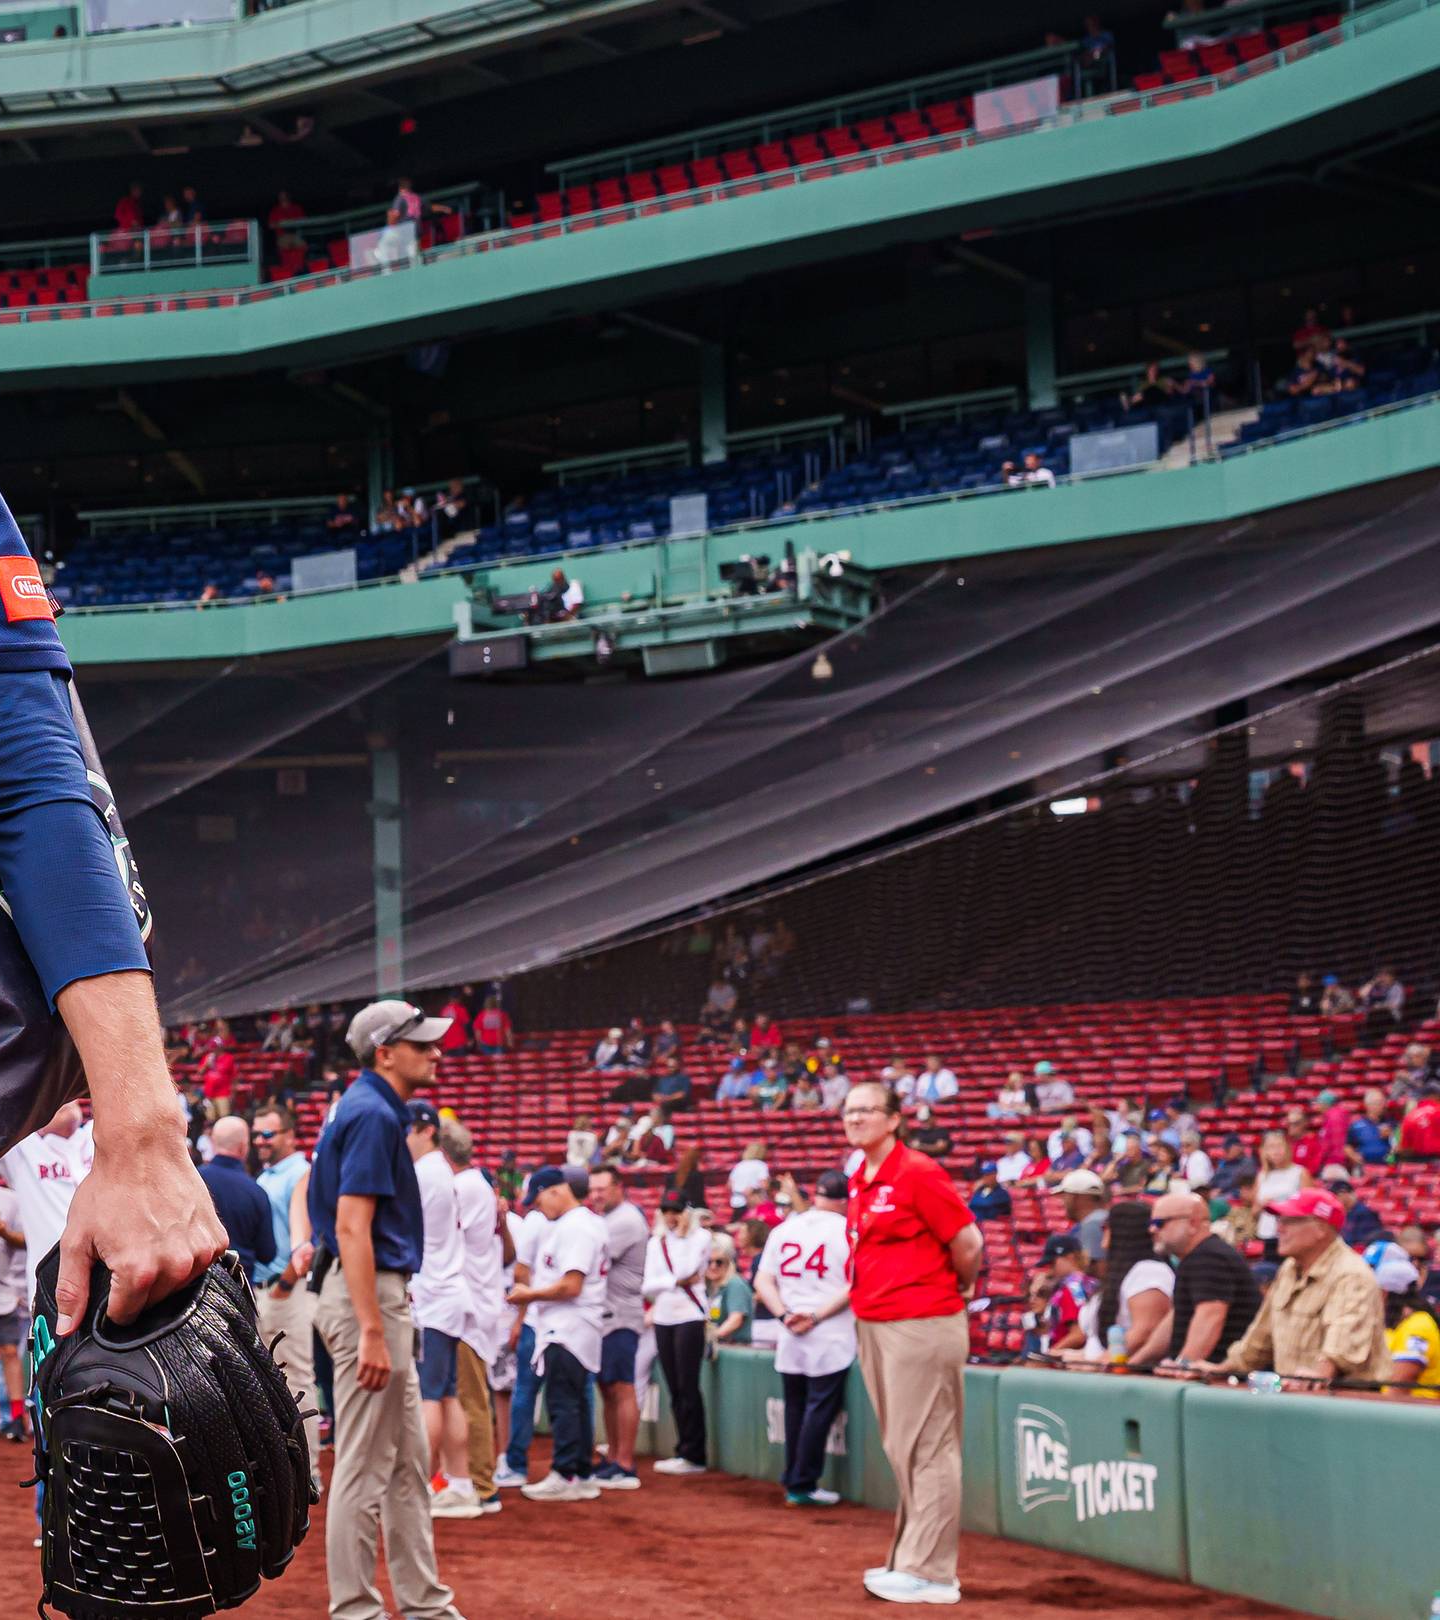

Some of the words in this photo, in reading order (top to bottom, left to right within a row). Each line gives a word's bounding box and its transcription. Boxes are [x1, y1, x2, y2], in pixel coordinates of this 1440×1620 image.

[780, 1242, 828, 1279] 24
[1024, 1430, 1069, 1482] ACE
[227, 1471, 257, 1549] A2000
[1070, 1460, 1158, 1522] TICKET
